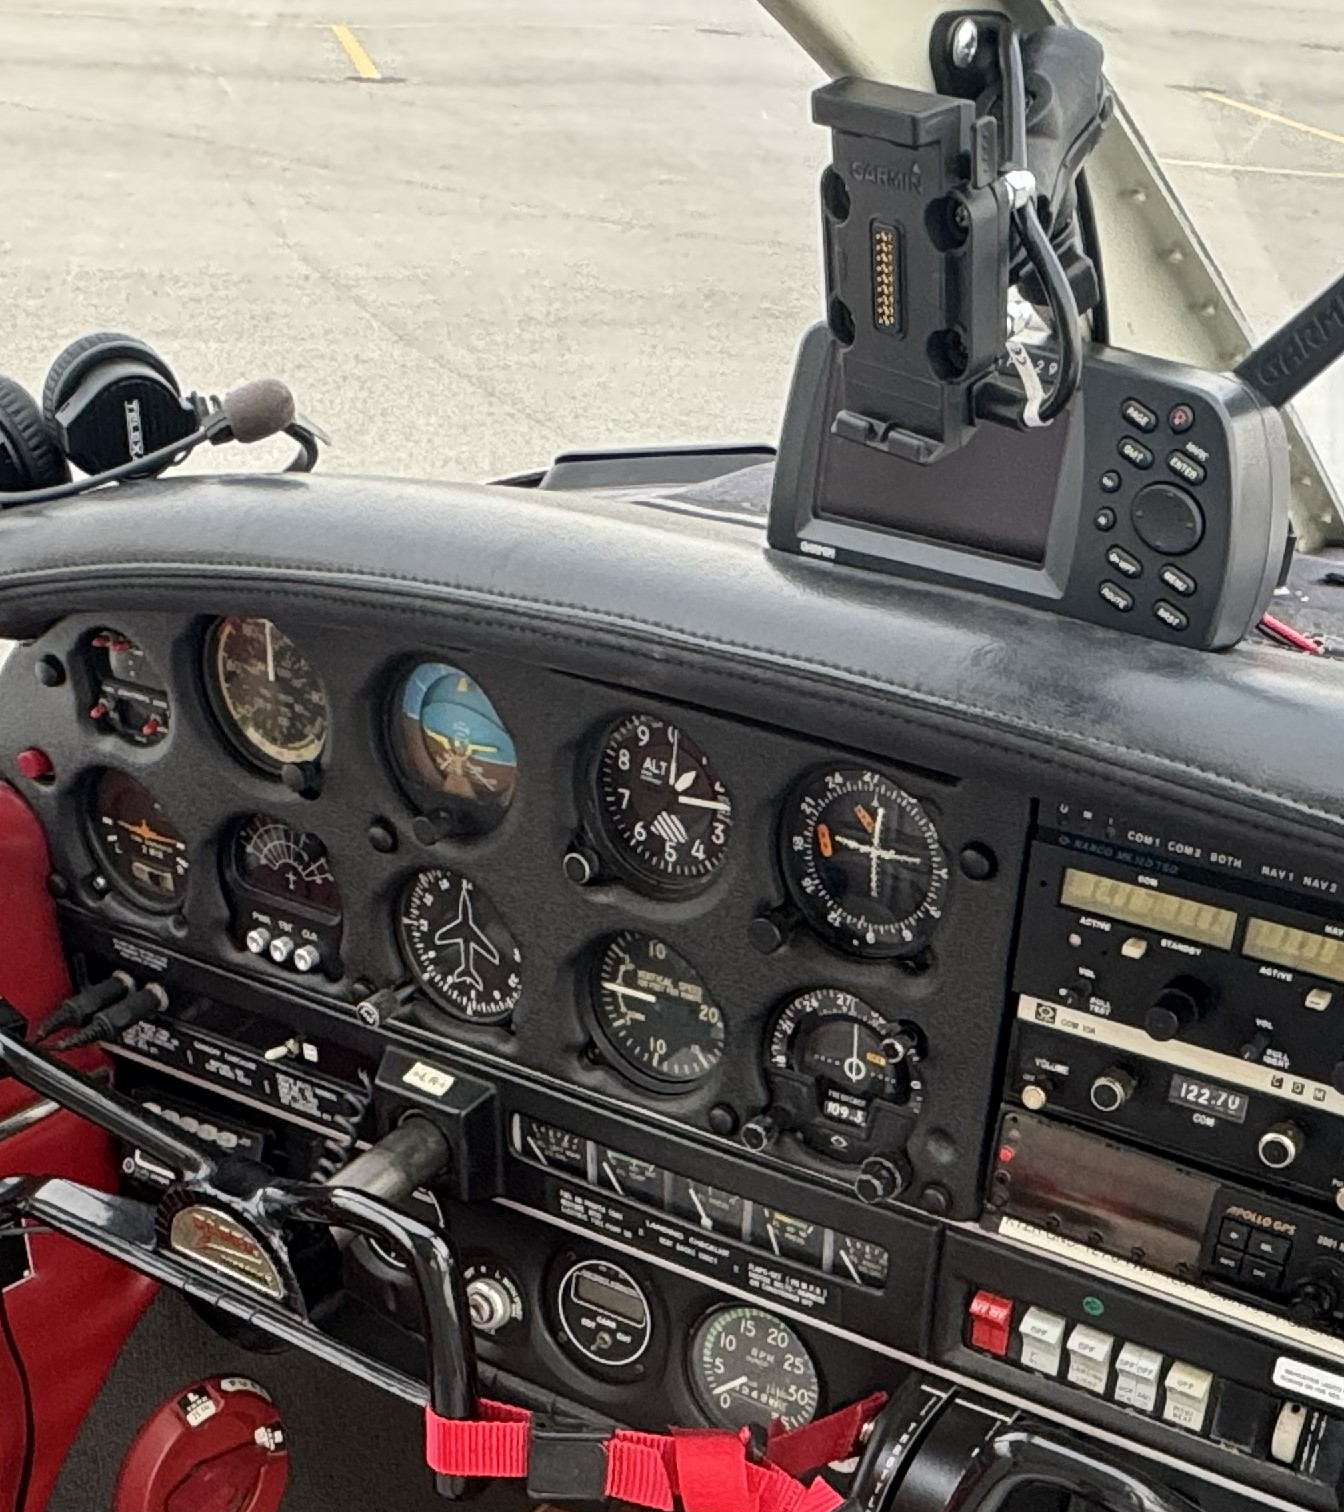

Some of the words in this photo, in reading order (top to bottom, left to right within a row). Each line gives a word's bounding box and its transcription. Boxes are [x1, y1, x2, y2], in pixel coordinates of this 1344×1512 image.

[852, 163, 924, 194] GARMIN
[1126, 406, 1149, 426] PAGE
[1170, 457, 1198, 479] ENTER
[637, 725, 650, 746] 9
[618, 749, 630, 770] 8
[643, 757, 668, 776] ALT
[617, 788, 631, 810] 7
[634, 821, 647, 841] 6
[712, 822, 725, 845] 3
[664, 841, 677, 862] 5
[691, 838, 706, 860] 4
[1074, 839, 1113, 857] NARCO
[1210, 852, 1243, 869] BOTH
[1079, 916, 1112, 932] ACTIVE
[648, 939, 667, 960] 10
[1160, 938, 1202, 956] STANDBY
[1259, 966, 1294, 982] ACTIVE
[699, 1004, 720, 1024] 20
[1060, 1018, 1080, 1030] COM
[649, 1036, 667, 1056] 10
[1034, 1057, 1070, 1075] VOLUME
[1192, 1112, 1216, 1127] COM
[1226, 1205, 1272, 1228] APOLLO
[1273, 1219, 1297, 1235] GPS
[740, 1319, 756, 1337] 15
[767, 1328, 789, 1348] 20
[720, 1332, 736, 1352] 10
[1078, 1341, 1096, 1353] OFF
[714, 1357, 725, 1374] 5
[783, 1353, 804, 1374] 25
[1136, 1364, 1154, 1376] OFF
[720, 1393, 731, 1409] 0
[787, 1385, 808, 1405] 30
